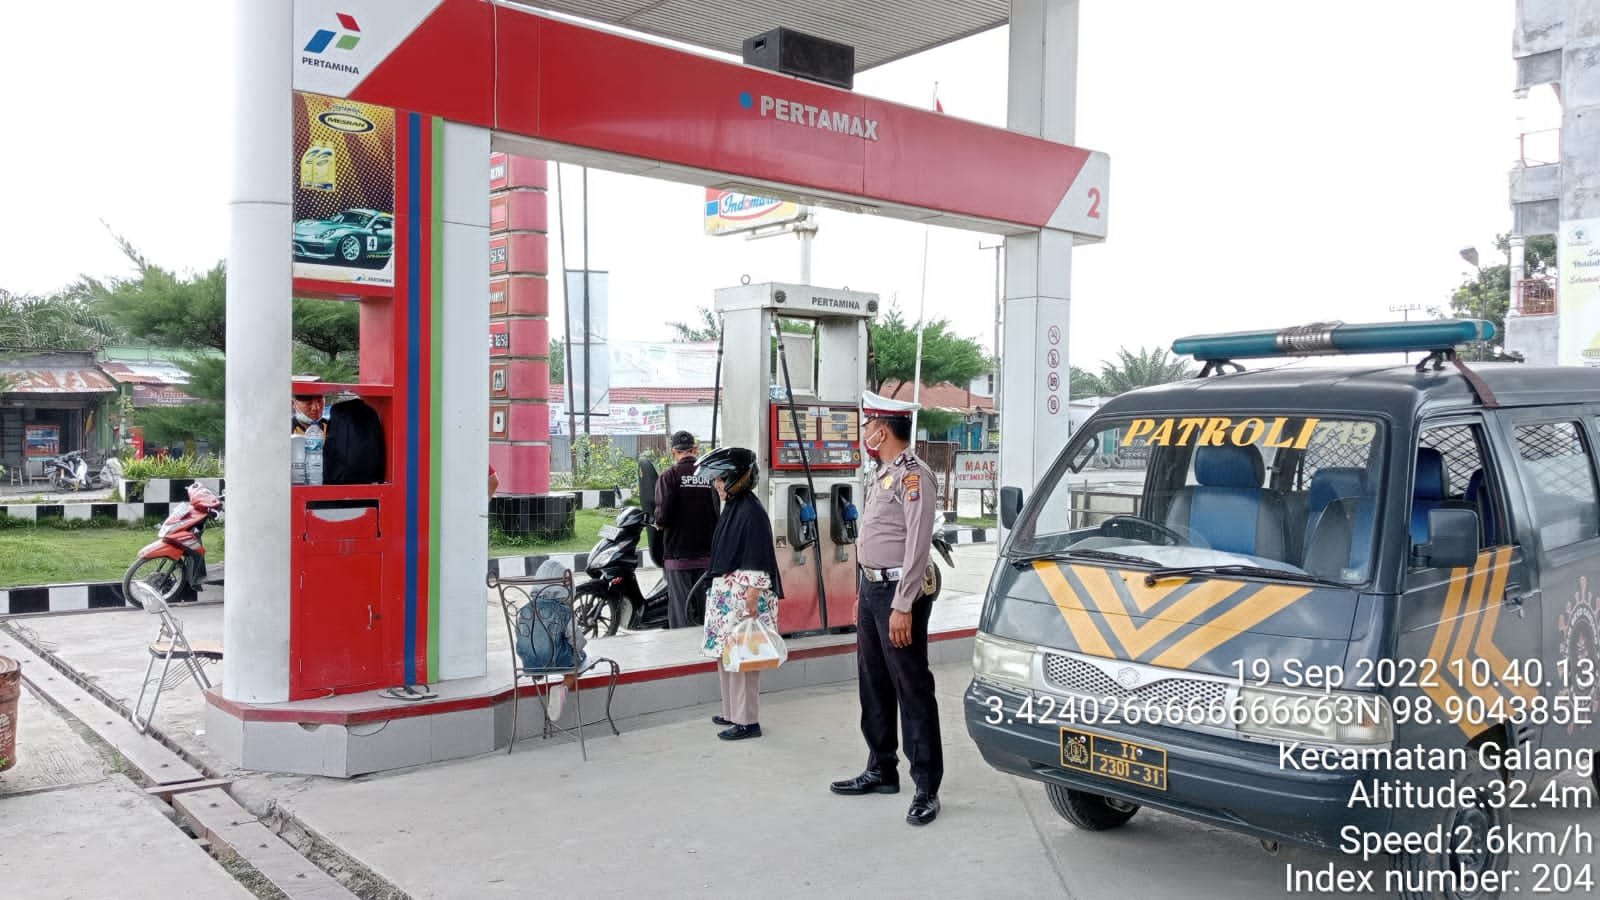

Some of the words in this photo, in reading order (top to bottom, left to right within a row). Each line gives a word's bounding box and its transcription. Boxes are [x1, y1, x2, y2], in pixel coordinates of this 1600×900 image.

[301, 56, 360, 75] PERTAMINA
[760, 95, 879, 140] PERTAMAX
[722, 192, 782, 214] Indoma
[1087, 187, 1101, 219] 2
[811, 296, 860, 310] PERTAMINA
[1119, 416, 1321, 449] PATROLI
